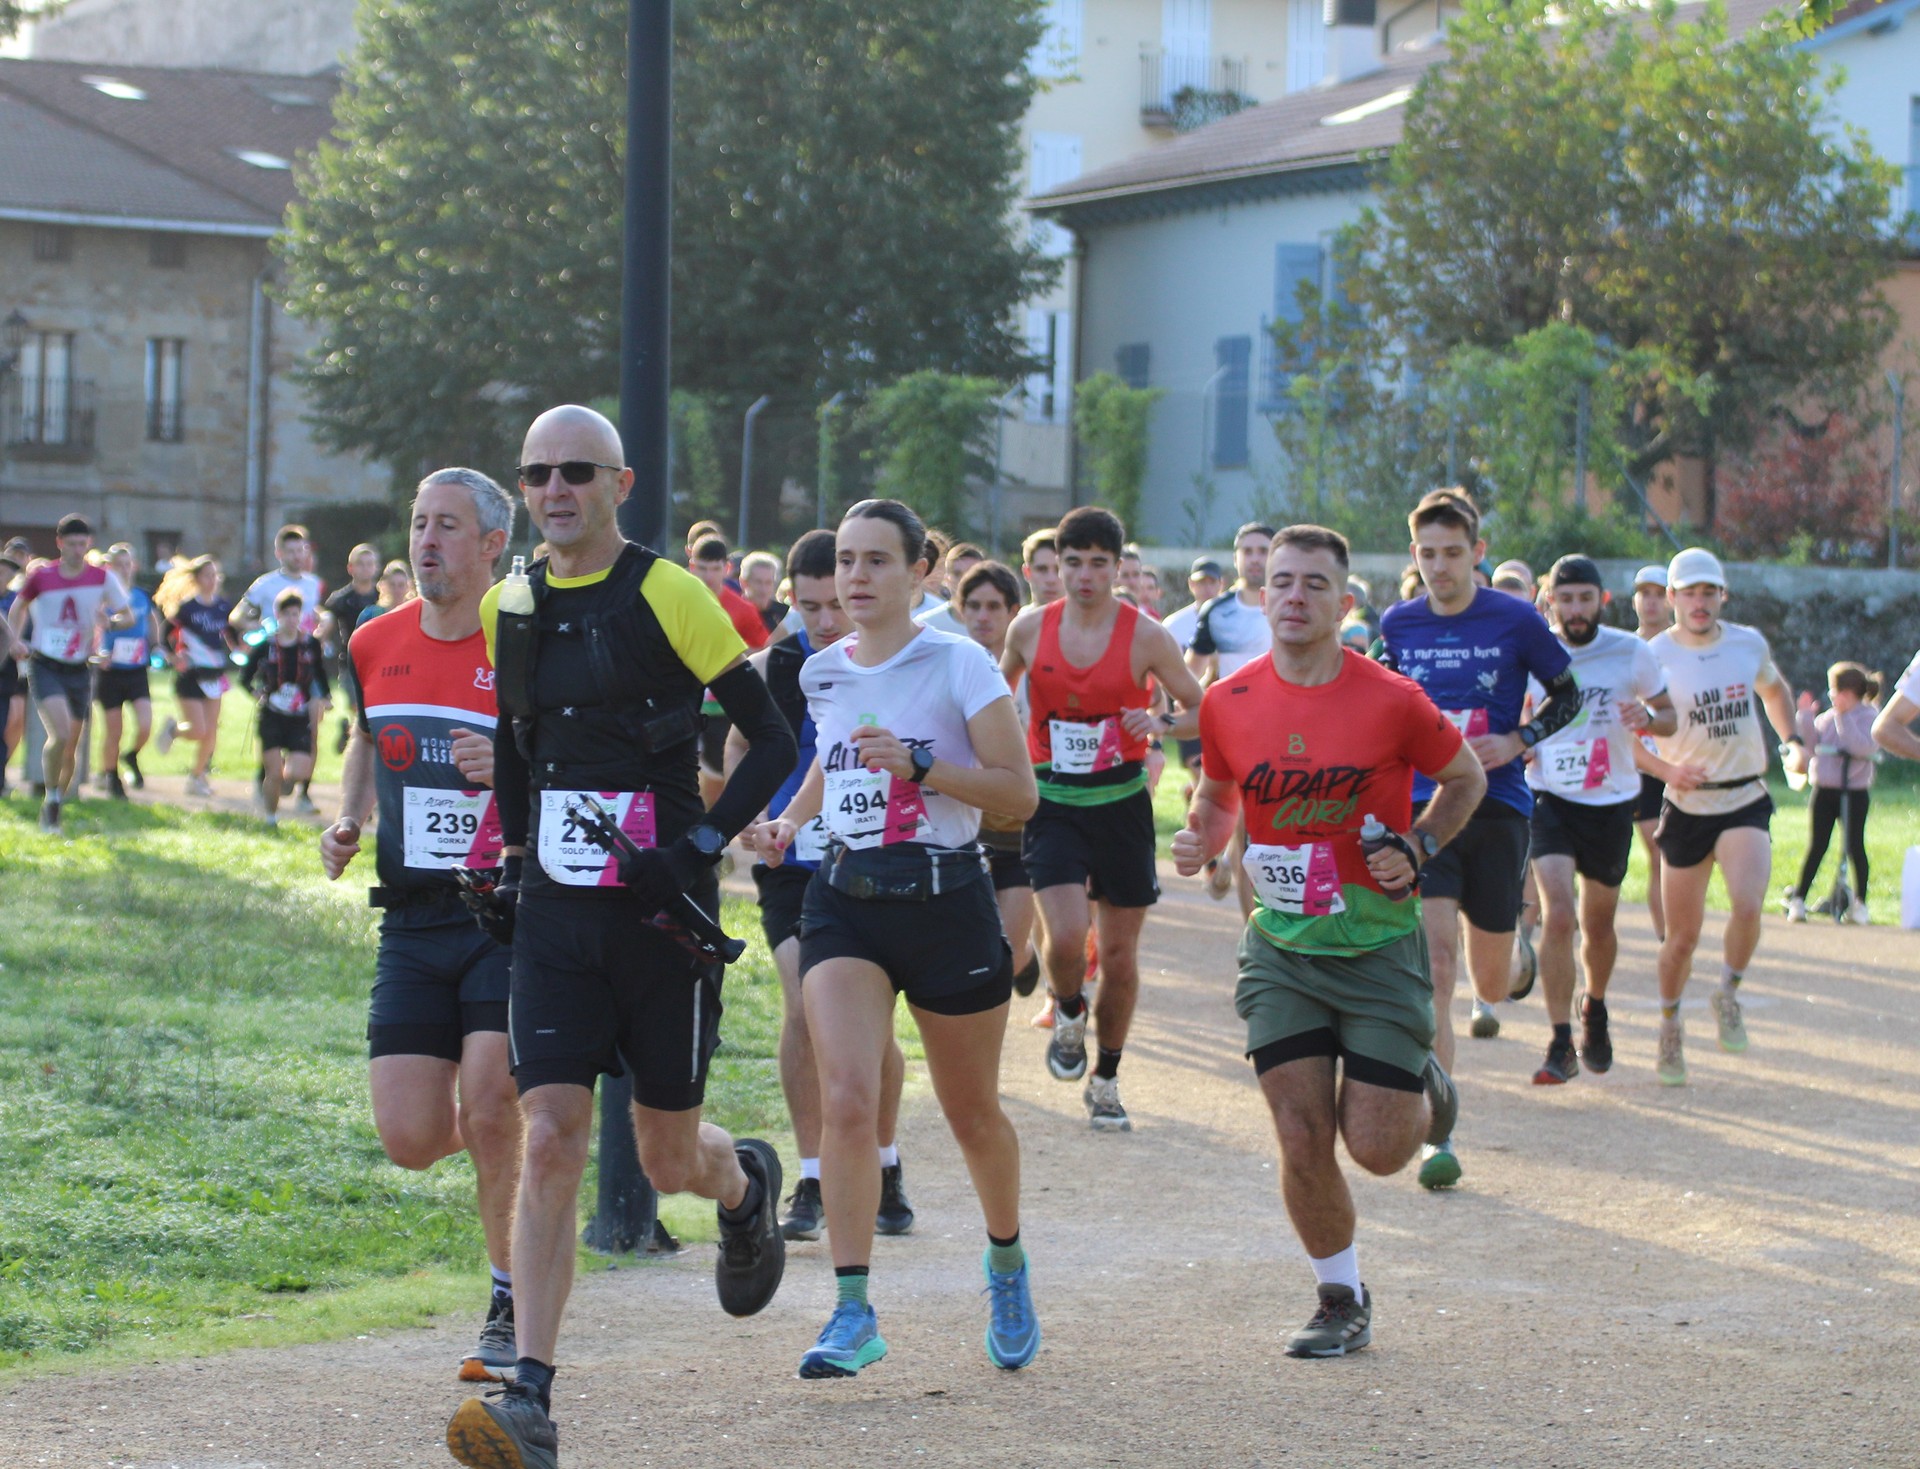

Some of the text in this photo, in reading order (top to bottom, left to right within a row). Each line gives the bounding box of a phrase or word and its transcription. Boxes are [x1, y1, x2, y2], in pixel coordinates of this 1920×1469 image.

[1693, 687, 1721, 707] LAU
[1706, 721, 1739, 740] TRAIL
[1065, 736, 1099, 752] 398
[1555, 755, 1588, 771] 274
[1240, 761, 1378, 805] ALDAPE
[838, 789, 888, 816] 494
[854, 815, 878, 826] IRATI
[1271, 795, 1359, 831] GORA
[426, 812, 478, 835] 239
[437, 837, 467, 845] GORKA
[1262, 865, 1306, 885] 336
